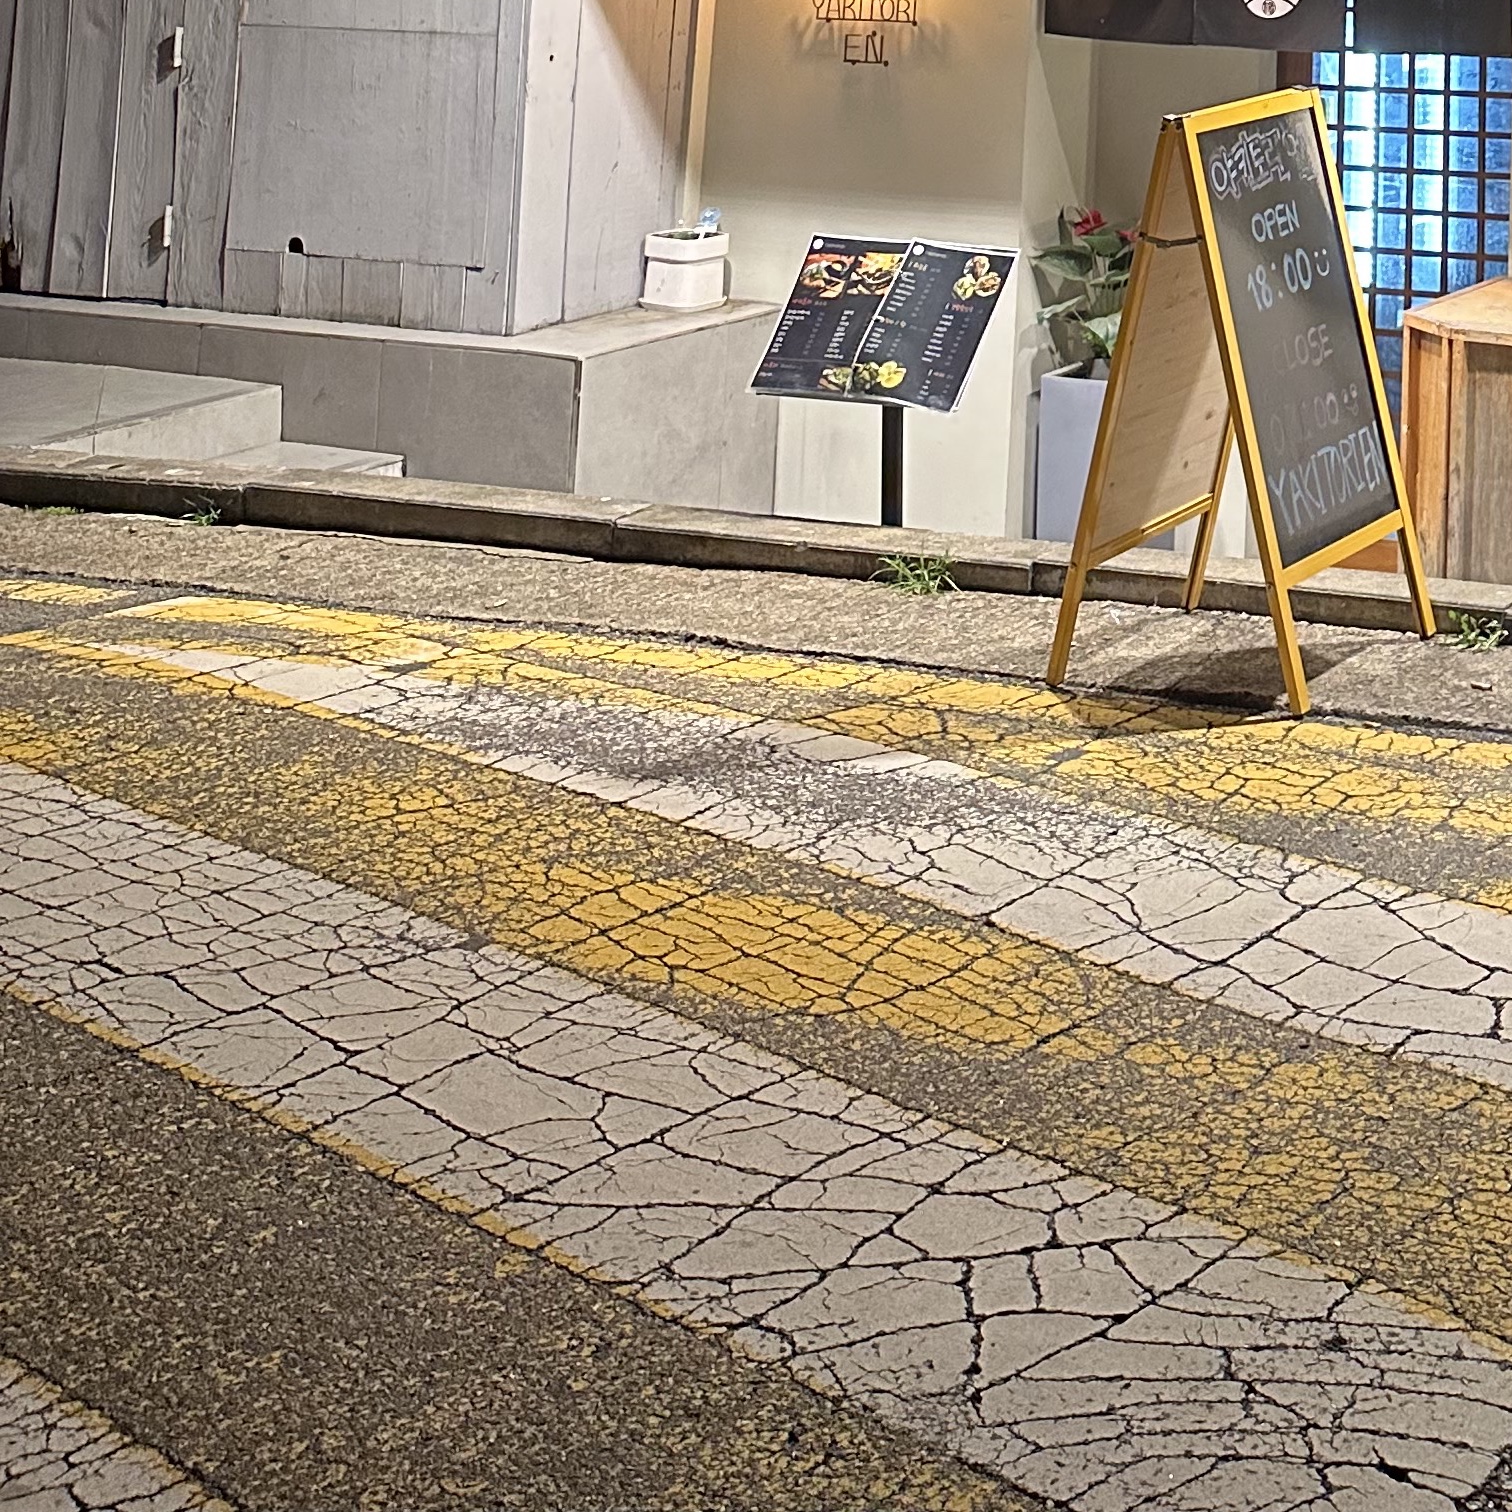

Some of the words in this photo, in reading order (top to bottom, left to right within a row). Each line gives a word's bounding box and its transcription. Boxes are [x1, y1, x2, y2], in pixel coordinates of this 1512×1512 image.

[843, 33, 886, 65] EN
[1251, 200, 1301, 244] OPEN
[1247, 247, 1313, 313] 18:00
[1272, 323, 1334, 376] CLOSE
